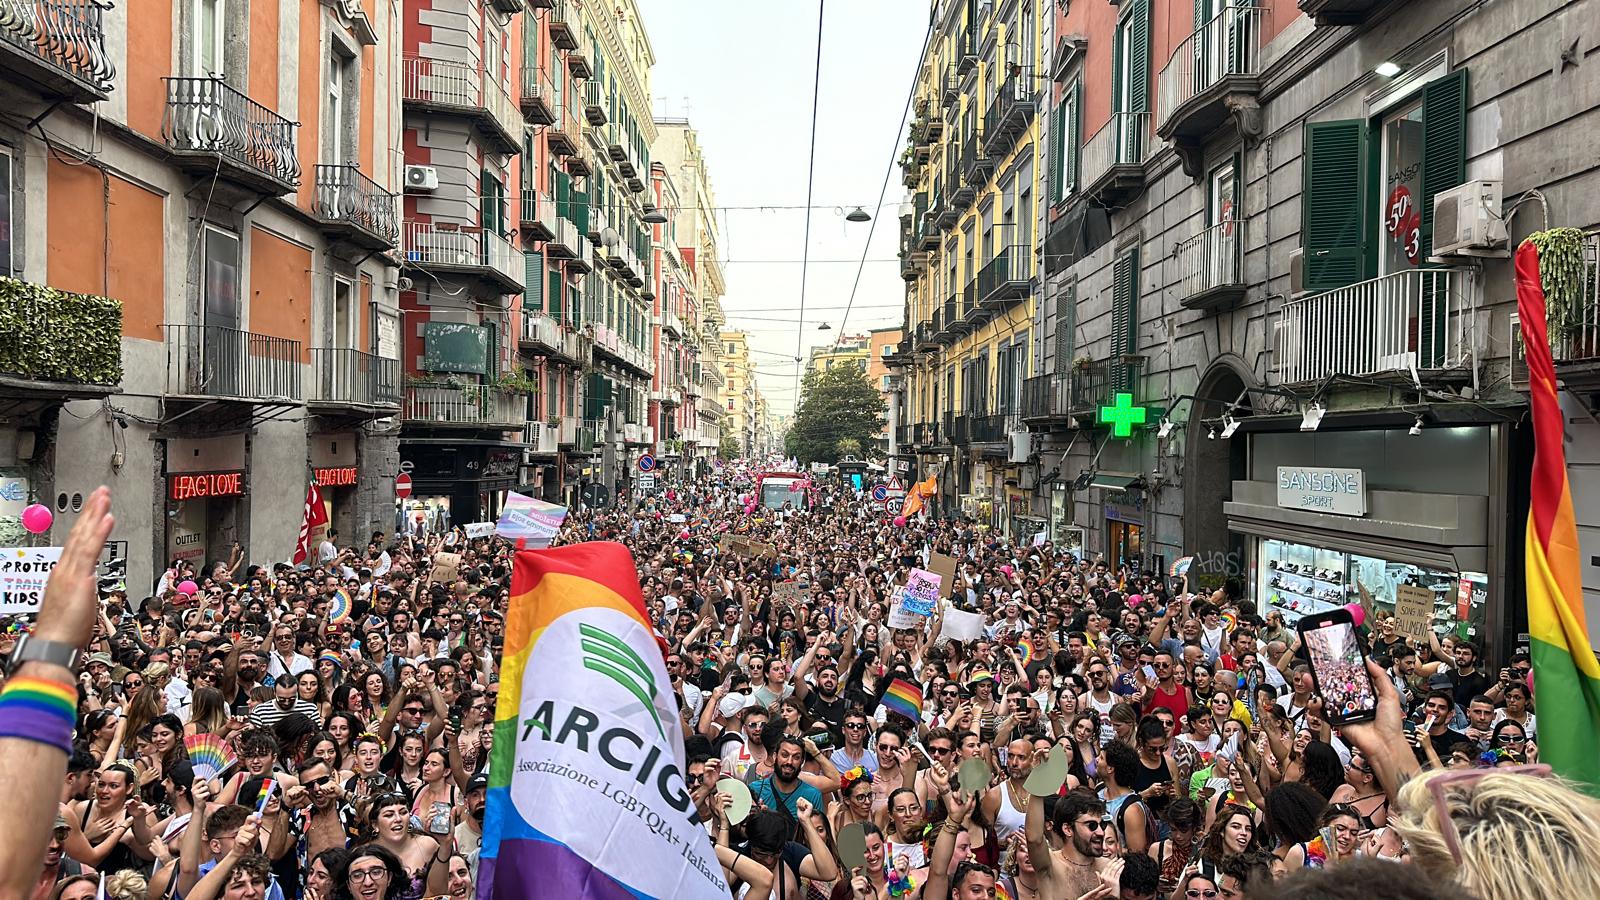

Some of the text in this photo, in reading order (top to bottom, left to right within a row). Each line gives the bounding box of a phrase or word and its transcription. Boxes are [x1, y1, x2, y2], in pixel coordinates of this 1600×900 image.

[1388, 162, 1421, 185] SANSO
[1404, 227, 1420, 259] -3
[466, 460, 480, 470] 49
[1280, 471, 1359, 494] SANSONE
[888, 502, 900, 511] 30
[1302, 495, 1333, 508] SPORT
[175, 533, 201, 546] OUTLET
[2, 561, 57, 574] PROTEC
[3, 591, 39, 606] KIDS
[521, 700, 702, 826] ARCIG
[517, 759, 726, 893] Associazione LGBTQIA+ Italiana
